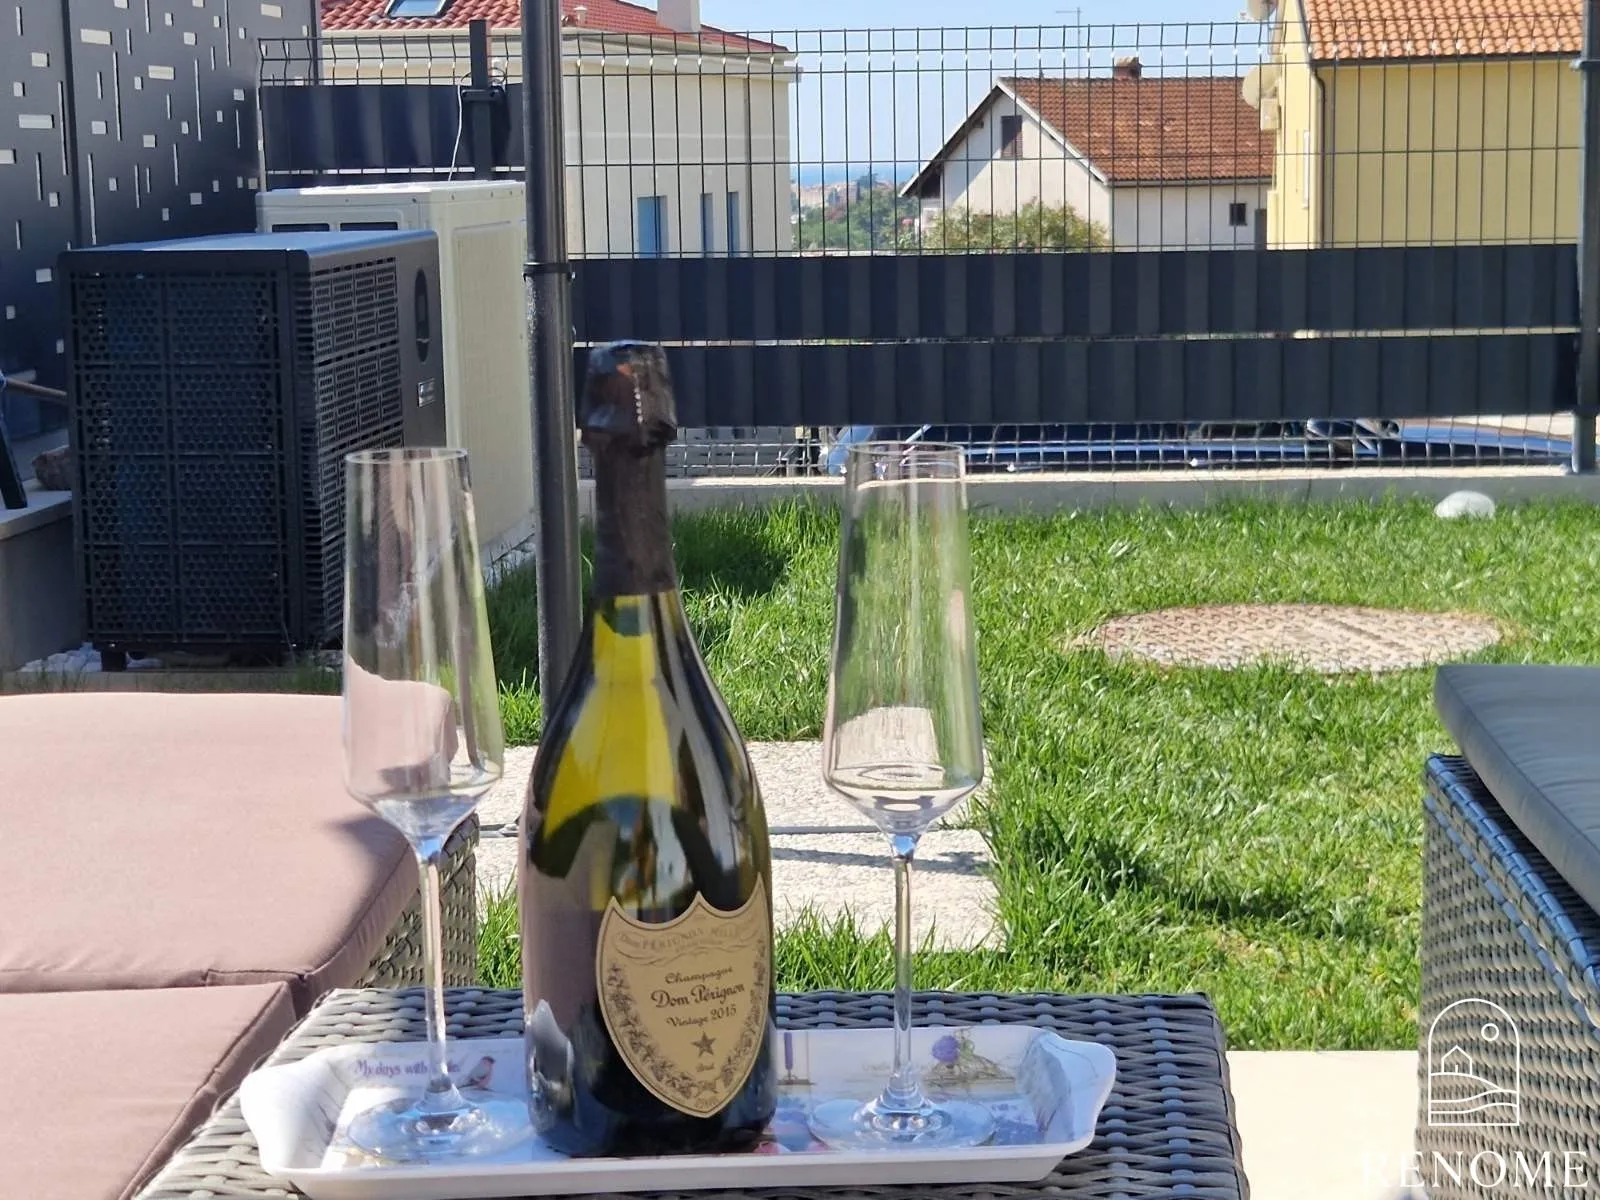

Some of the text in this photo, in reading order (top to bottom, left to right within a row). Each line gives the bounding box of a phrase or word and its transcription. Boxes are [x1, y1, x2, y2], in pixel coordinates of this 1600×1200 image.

[664, 965, 733, 985] Champagne
[651, 988, 690, 1009] Dom
[666, 1004, 737, 1029] Vintage 2015
